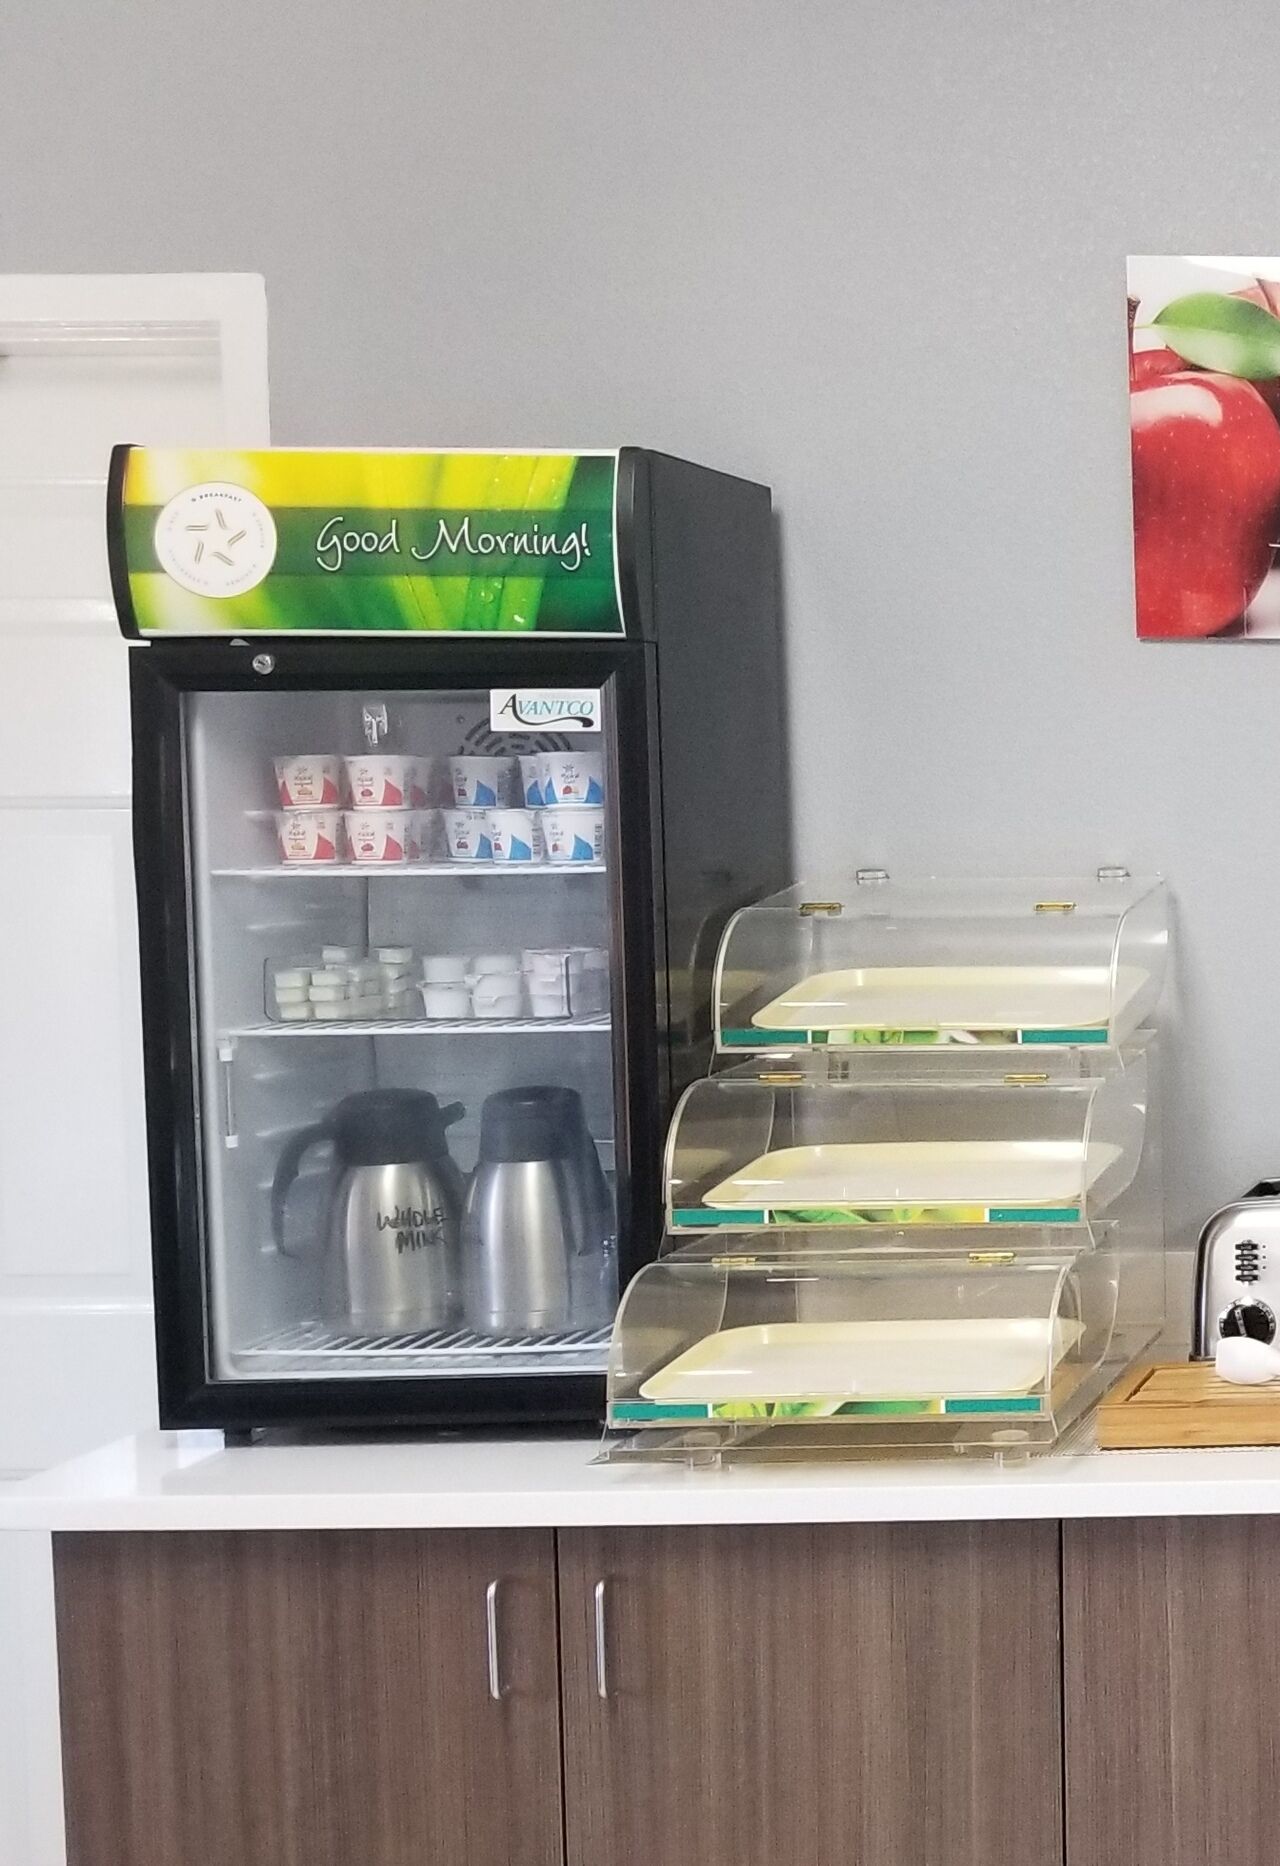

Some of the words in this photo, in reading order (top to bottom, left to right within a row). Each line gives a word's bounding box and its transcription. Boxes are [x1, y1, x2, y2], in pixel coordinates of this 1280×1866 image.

[316, 516, 400, 571] Good
[411, 516, 592, 571] Morning!
[497, 693, 594, 728] AVANTCO
